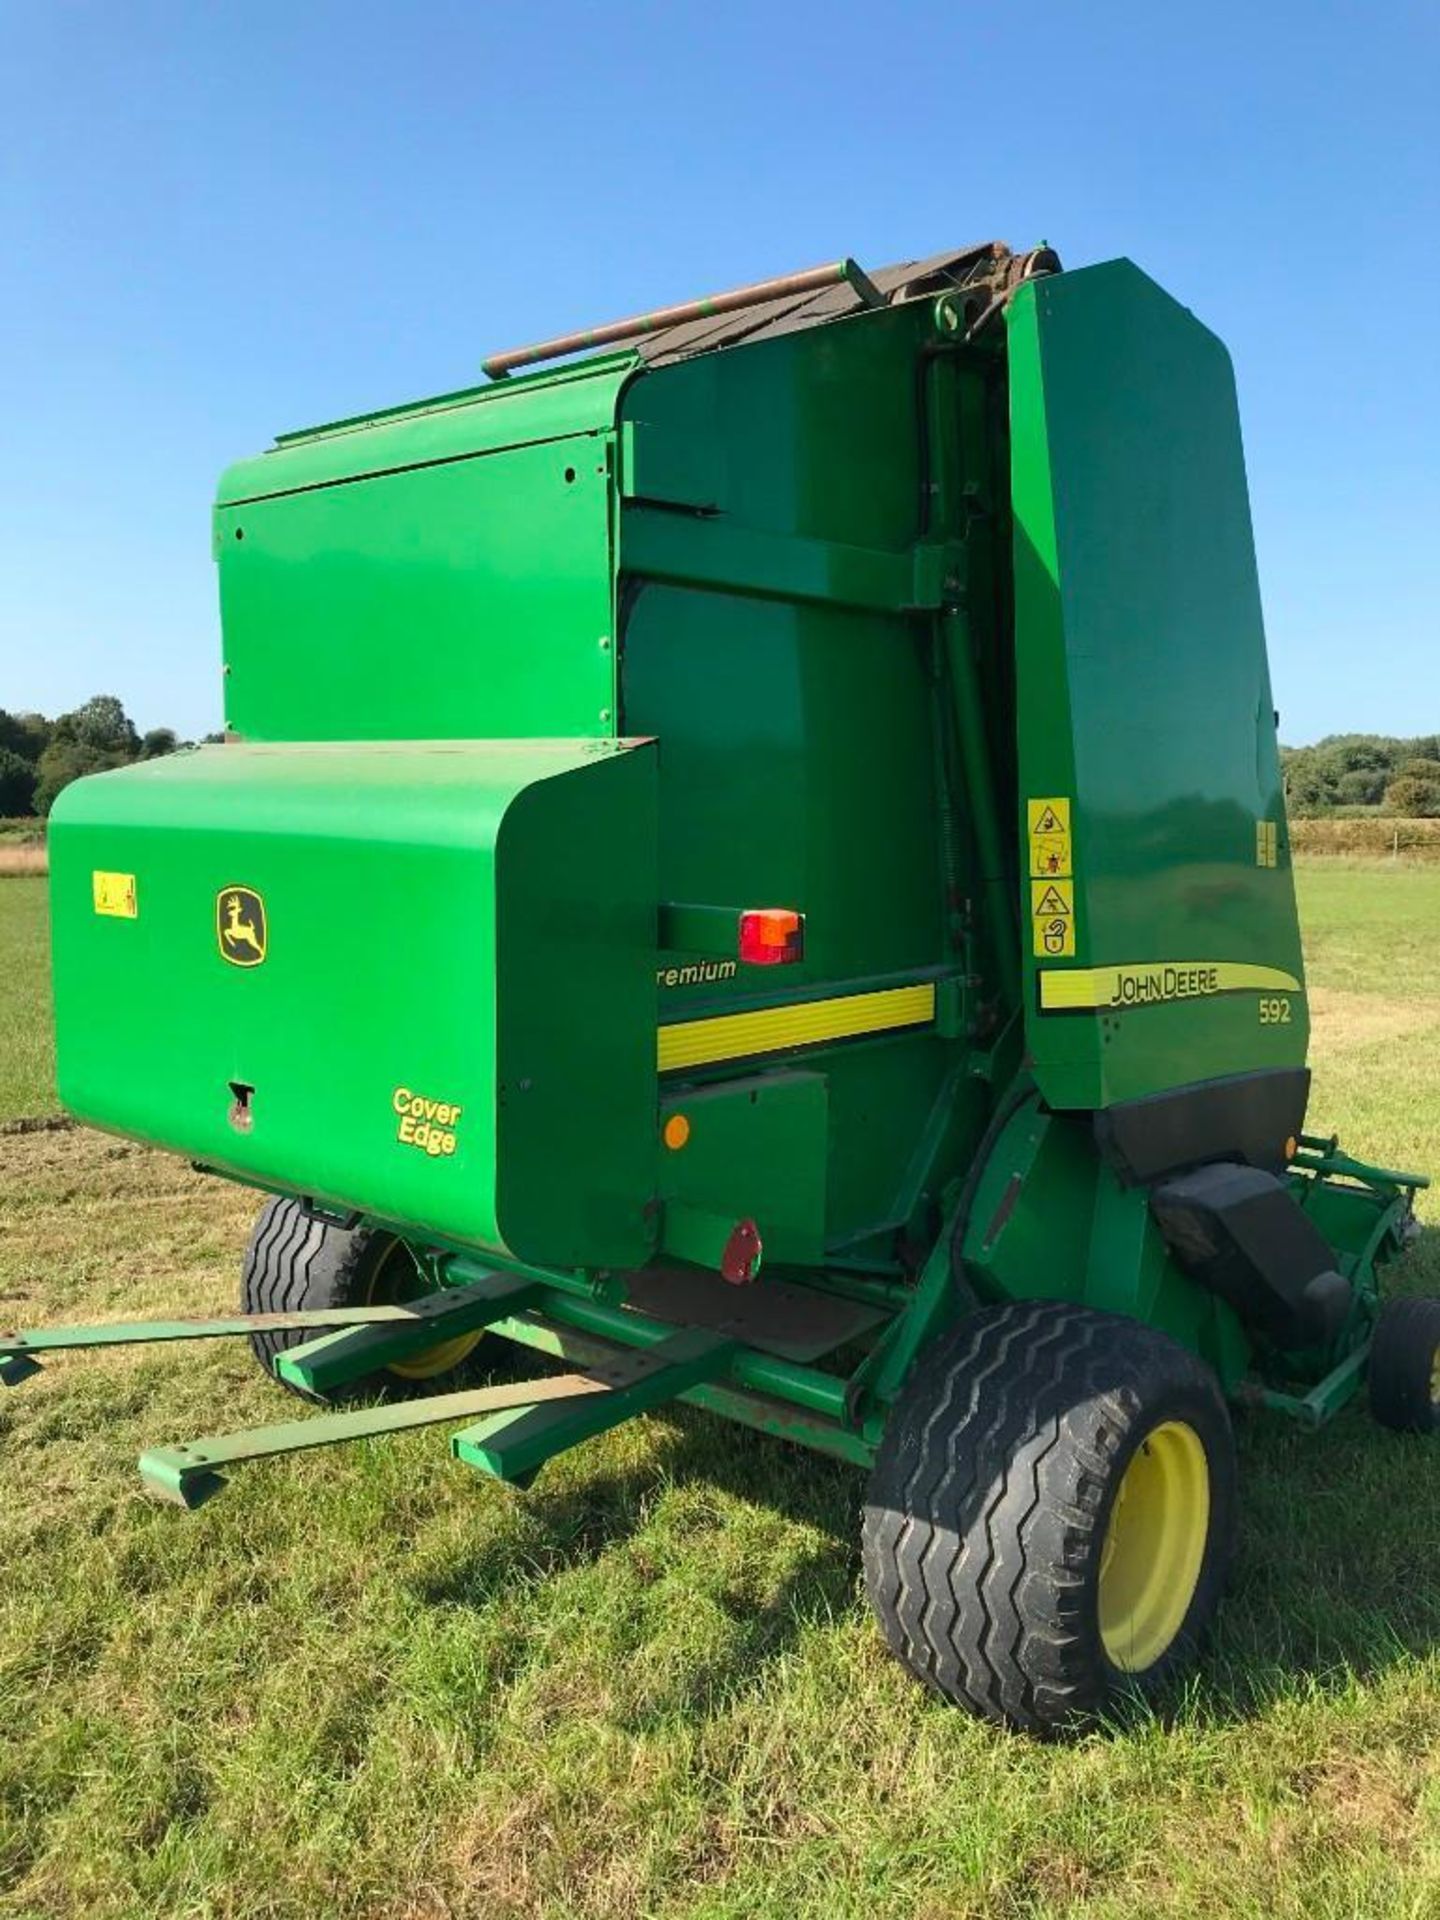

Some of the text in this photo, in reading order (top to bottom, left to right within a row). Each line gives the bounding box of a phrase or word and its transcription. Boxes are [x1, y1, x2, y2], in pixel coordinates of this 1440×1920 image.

[656, 960, 737, 987] remium
[1111, 968, 1218, 1003] JOHN DEERE
[1259, 998, 1292, 1024] 592
[393, 1086, 462, 1126] Cover
[398, 1115, 457, 1156] Edge
